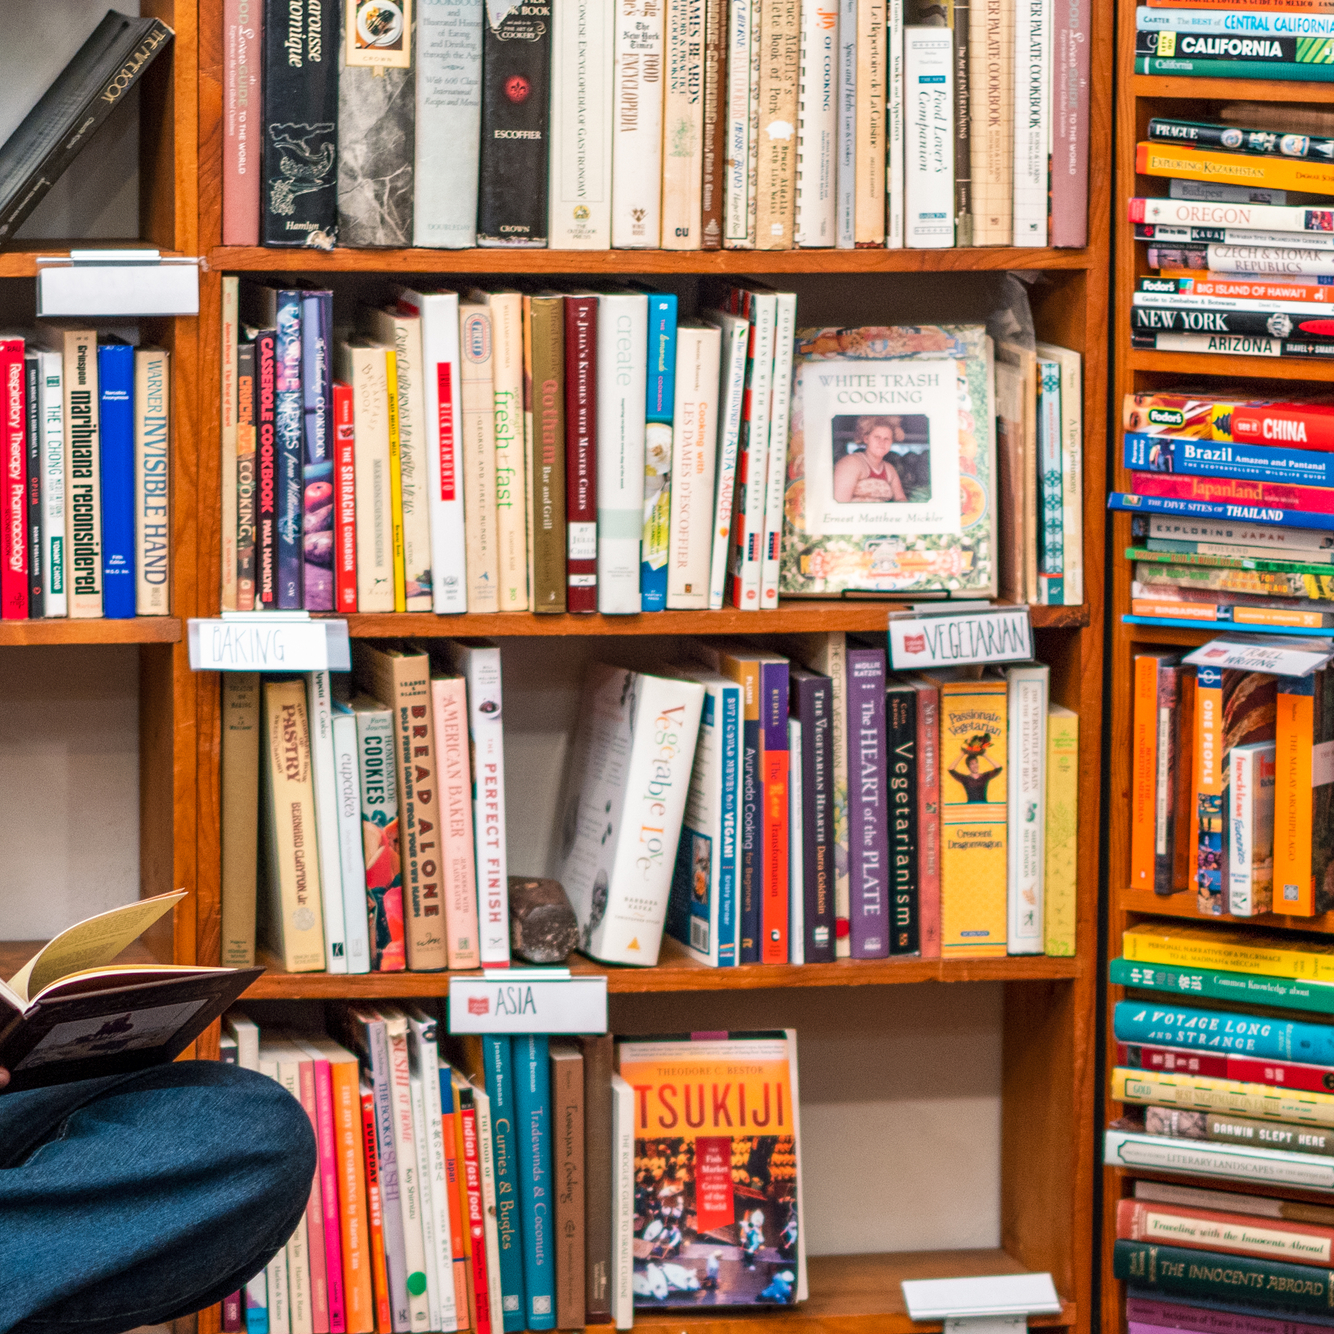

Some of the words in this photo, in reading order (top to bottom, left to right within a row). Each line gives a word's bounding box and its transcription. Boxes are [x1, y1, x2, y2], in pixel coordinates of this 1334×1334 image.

[1224, 15, 1270, 30] CENTRAL
[1181, 38, 1282, 57] CALIFORNIA
[495, 130, 541, 140] ESCOFFIER
[1155, 124, 1198, 139] PRAGUE
[1176, 206, 1251, 223] OREGON
[1214, 247, 1255, 260] CZECH
[1257, 248, 1268, 260] &
[1272, 249, 1322, 262] SLOVAK
[1235, 261, 1302, 273] REPUBLICS
[1143, 281, 1175, 291] Fodor's
[1138, 310, 1175, 328] NEW
[1180, 311, 1228, 330] YORK
[1209, 338, 1272, 353] ARIZONA
[9, 363, 22, 428] Respiratory
[261, 338, 274, 422] CASSEROLE
[819, 374, 877, 387] WHITE
[882, 374, 939, 387] TRASH
[838, 391, 923, 404] COOKING
[71, 391, 96, 478] marihuana
[1263, 419, 1306, 442] CHINA
[10, 433, 23, 479] Therapy
[144, 416, 166, 517] INVISIBLE
[261, 423, 274, 514] COOKBOOK
[1185, 445, 1232, 461] Brazil
[11, 484, 24, 573] Pharmacology
[72, 483, 99, 595] reconsidered
[144, 524, 166, 585] HAND
[212, 625, 284, 663] BAKING
[926, 616, 1025, 660] VEGETARIAN
[862, 702, 877, 725] The
[365, 737, 384, 805] COOKIES
[411, 706, 432, 805] BREAD
[862, 728, 879, 806] HEART
[485, 764, 499, 847] PERFECT
[863, 809, 879, 825] of
[863, 827, 879, 845] the
[894, 742, 912, 926] Vegetarianism
[418, 820, 439, 917] ALONE
[863, 850, 880, 915] PLATE
[488, 859, 501, 922] FINISH
[495, 987, 536, 1015] ASIA
[635, 1083, 783, 1129] TSUKIJI
[496, 1119, 511, 1175] Curries
[1214, 1123, 1253, 1139] DARWIN
[1259, 1128, 1293, 1143] SLEPT
[1299, 1133, 1325, 1147] HERE
[499, 1180, 512, 1194] &
[500, 1199, 515, 1250] Bugles
[1161, 1261, 1185, 1280] THE
[1189, 1264, 1264, 1289] INNOCENTS
[1268, 1272, 1323, 1296] ABROAD
